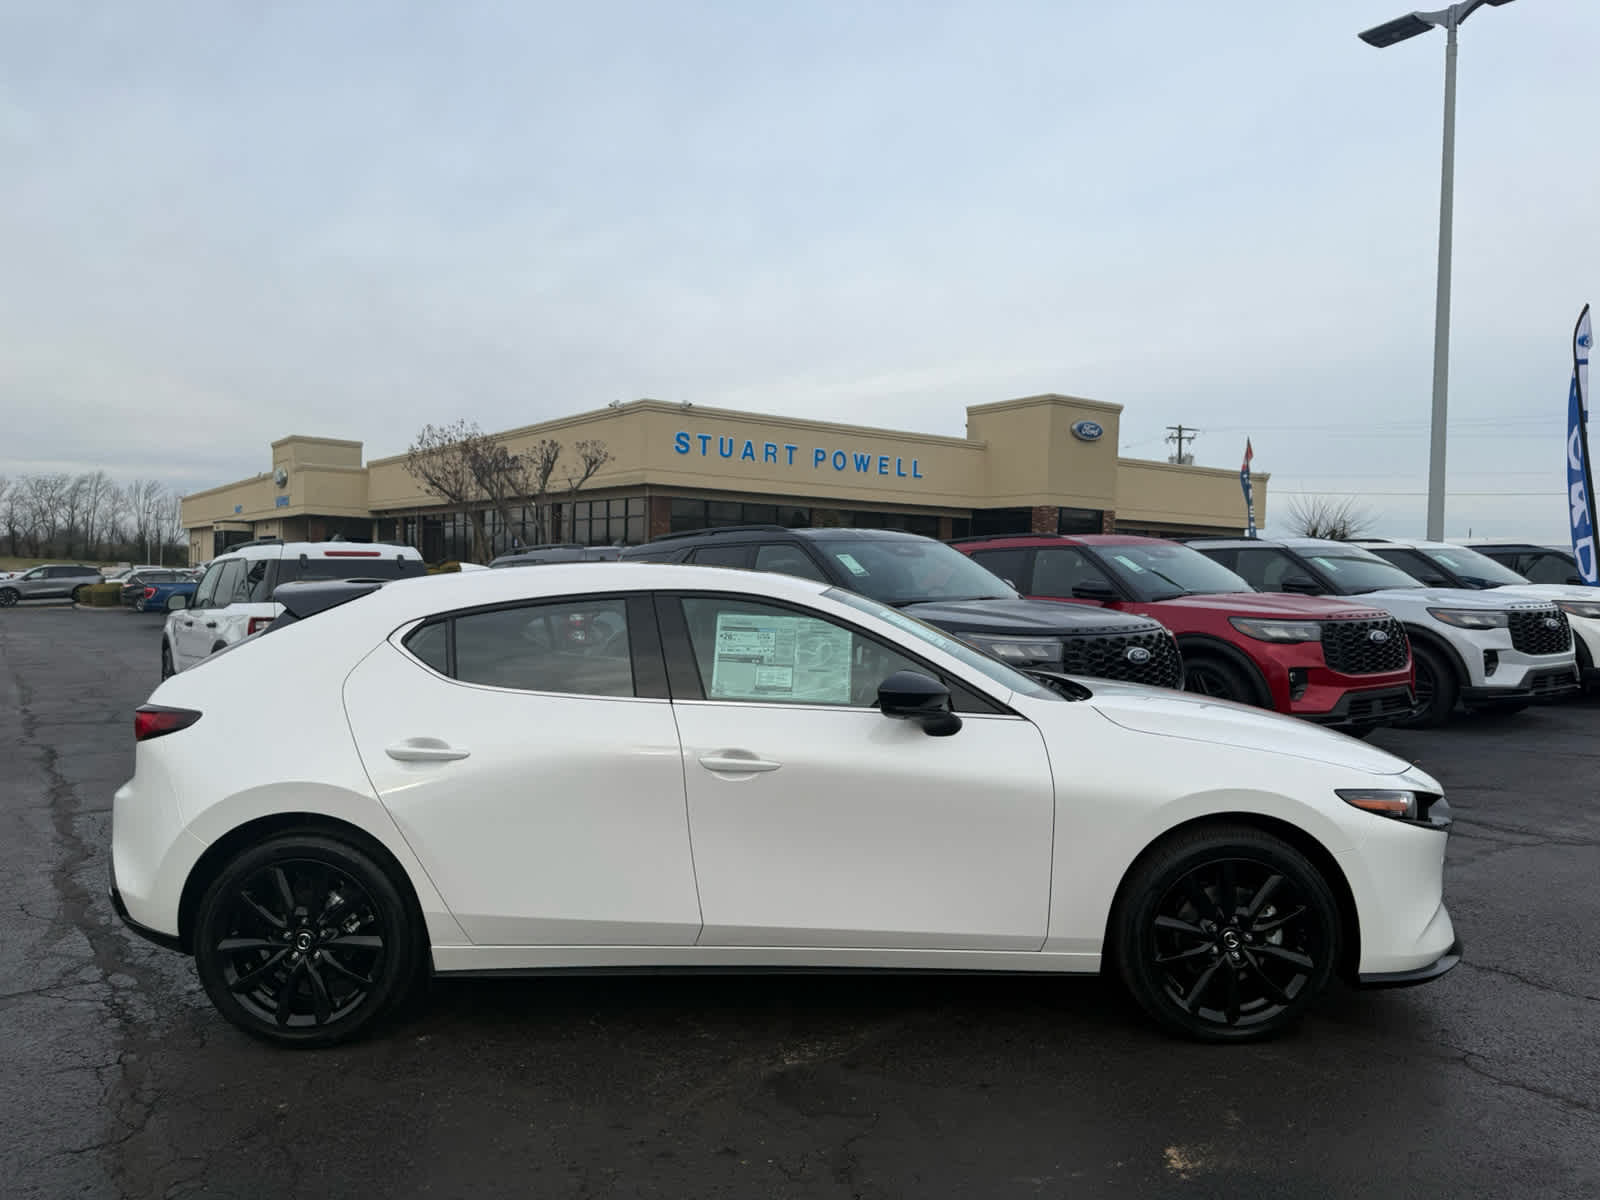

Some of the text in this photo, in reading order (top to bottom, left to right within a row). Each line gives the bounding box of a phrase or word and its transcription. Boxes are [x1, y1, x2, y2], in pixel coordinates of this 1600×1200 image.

[1080, 423, 1100, 436] Ford
[674, 431, 922, 479] STUART POWELL
